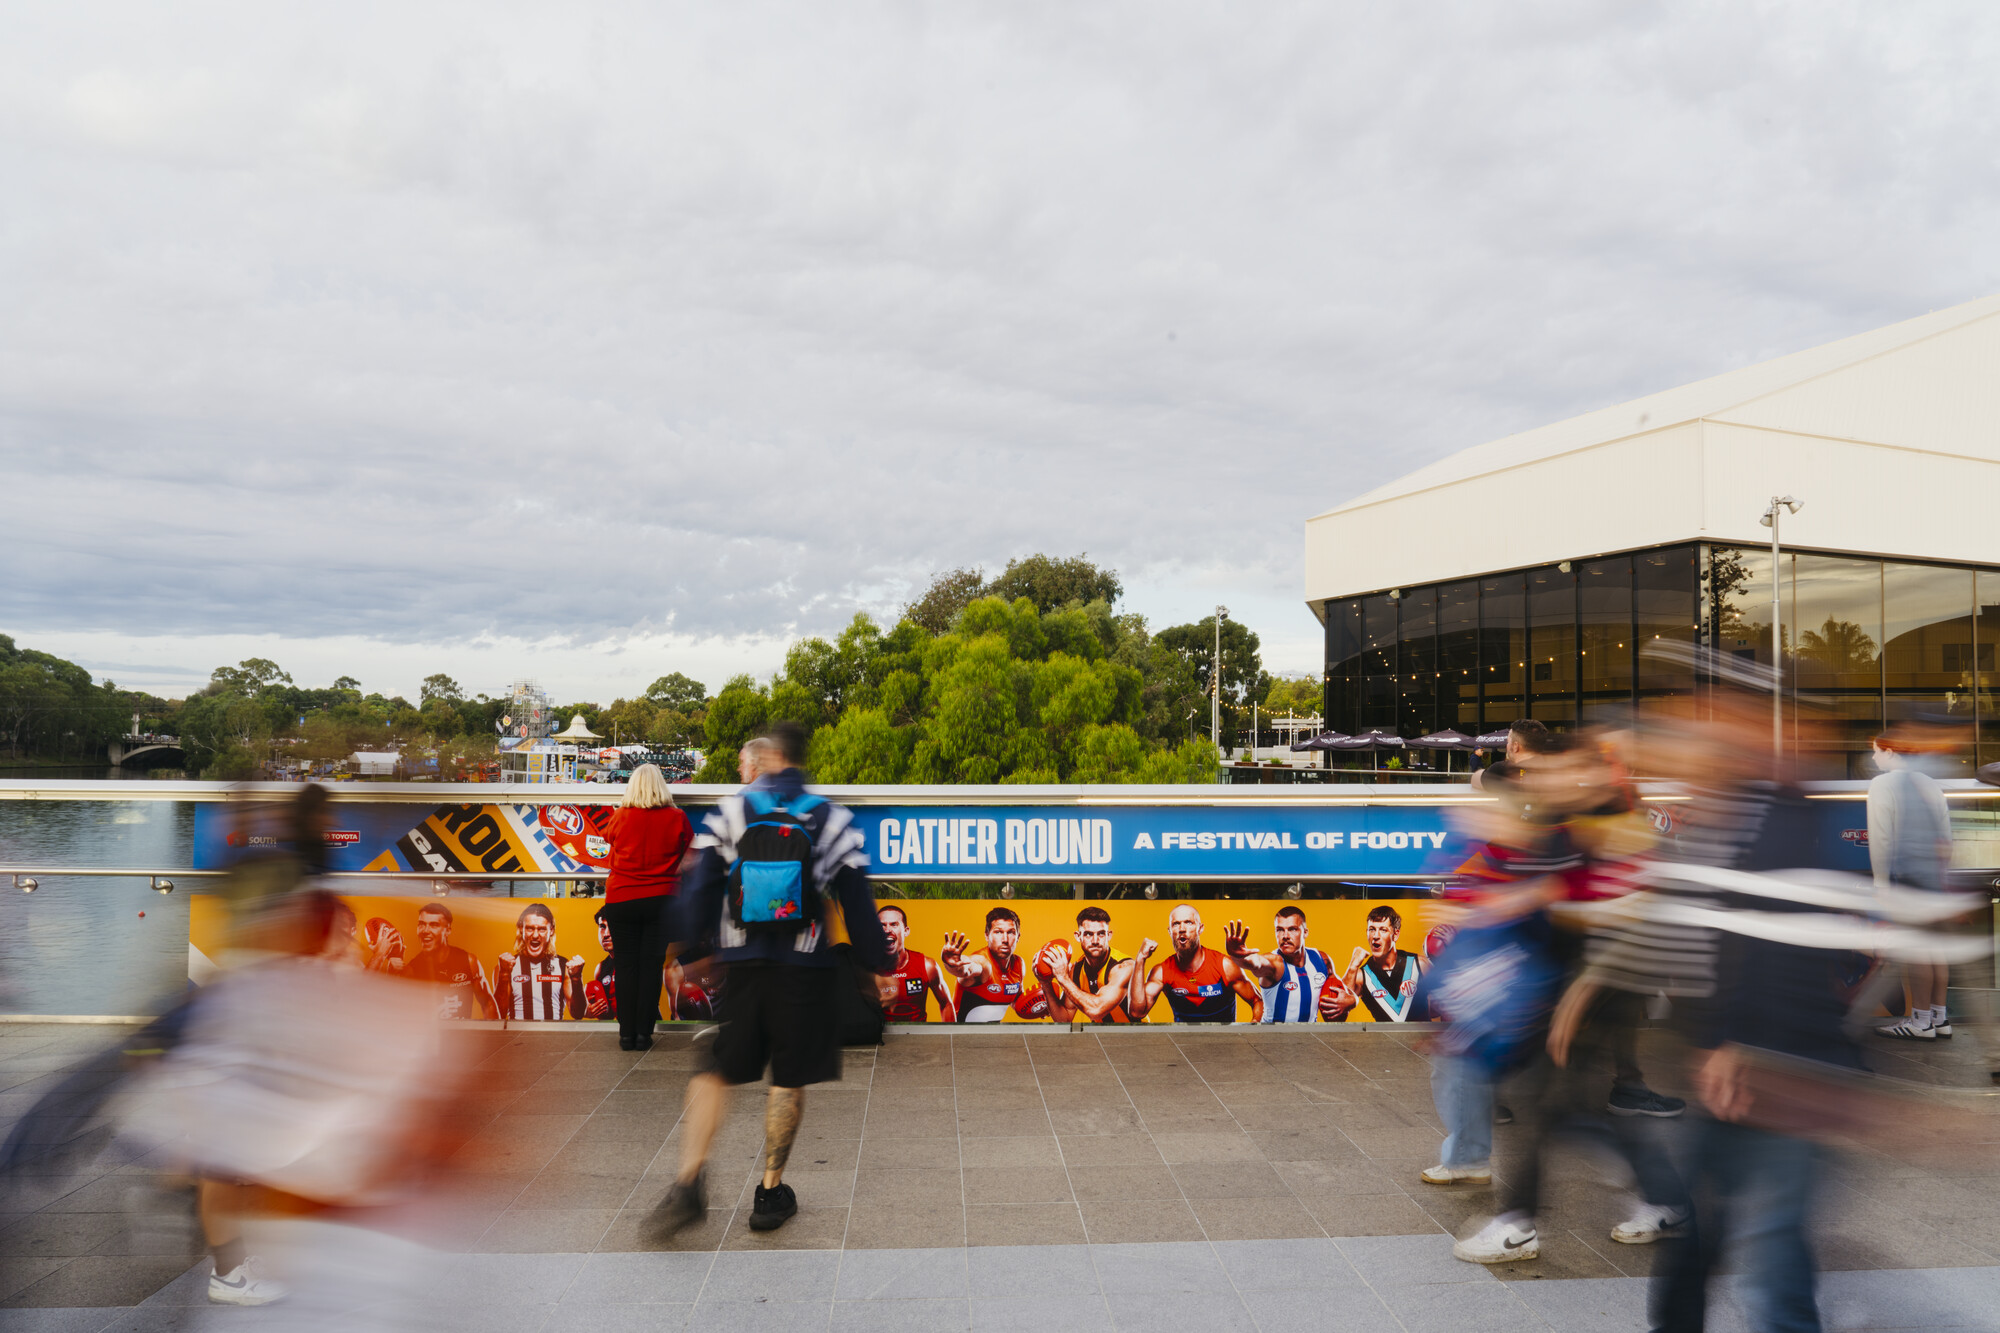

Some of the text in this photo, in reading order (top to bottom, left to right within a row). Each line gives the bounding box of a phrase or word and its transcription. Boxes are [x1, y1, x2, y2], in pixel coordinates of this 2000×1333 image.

[547, 804, 580, 834] AFL
[433, 804, 525, 872] ROU
[880, 818, 1112, 864] GATHER ROUND
[1133, 832, 1447, 849] A FESTIVAL OF FOOTY
[1401, 980, 1417, 997] MG
[1021, 995, 1045, 1013] SHERR
